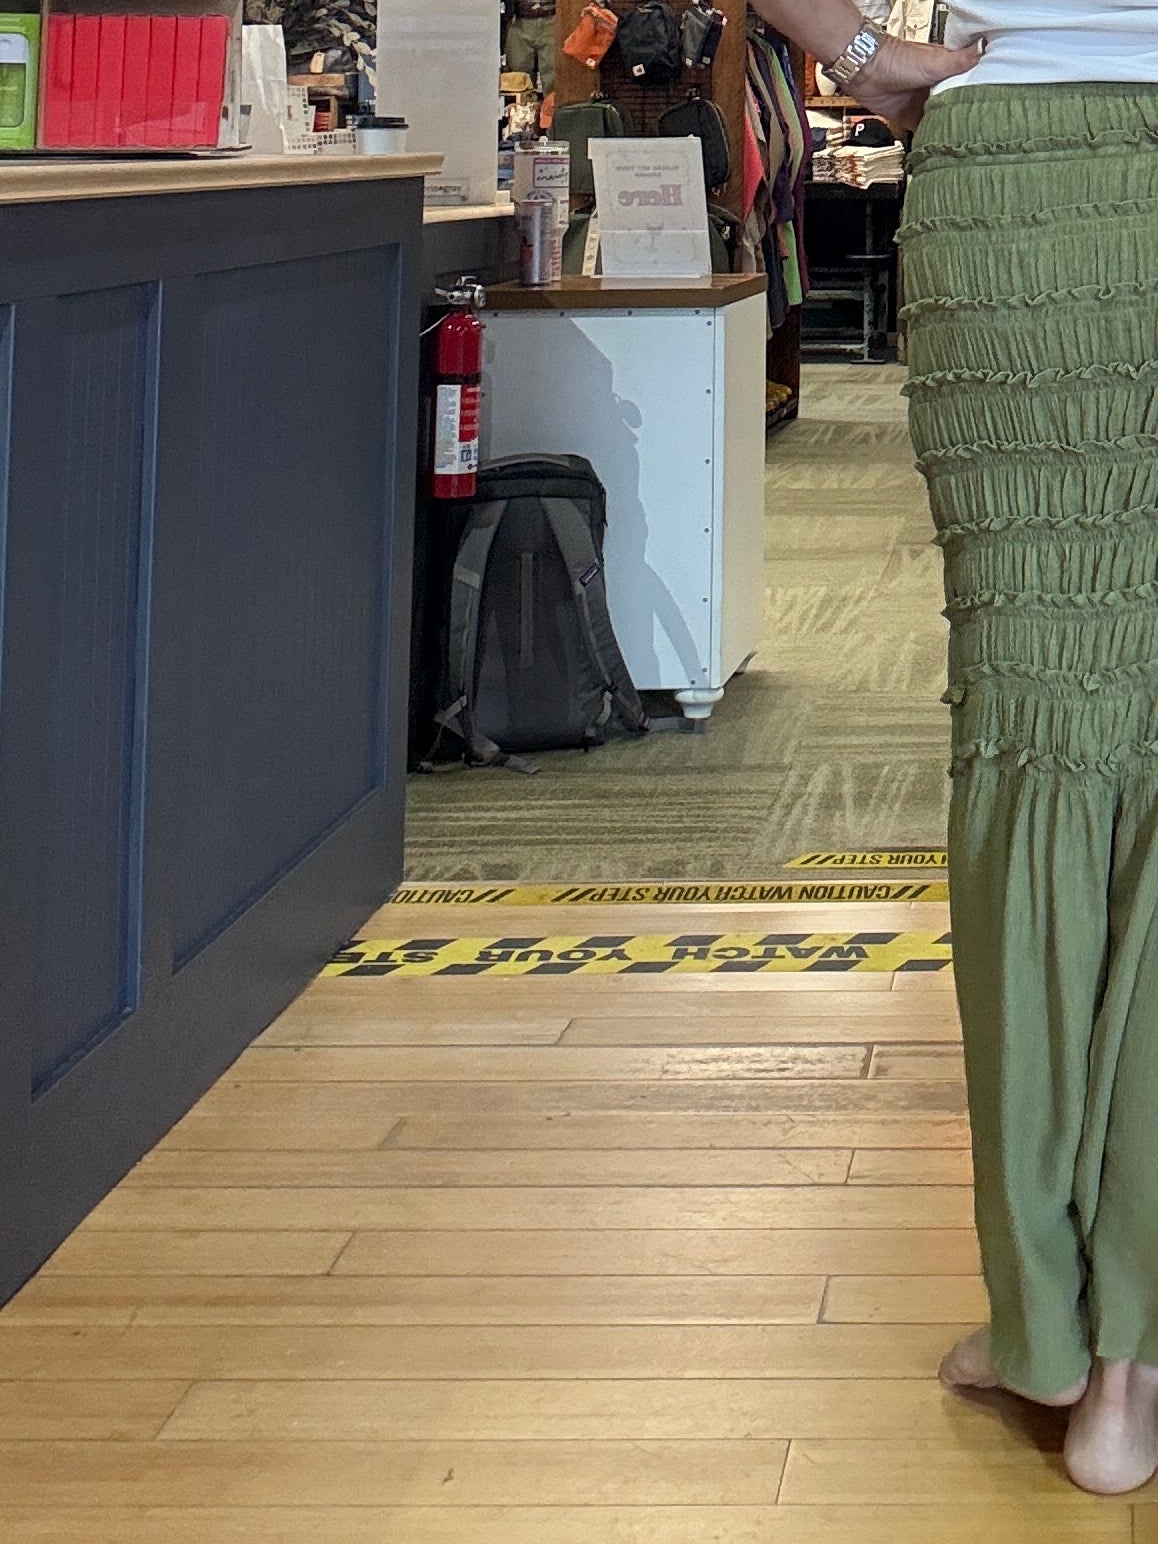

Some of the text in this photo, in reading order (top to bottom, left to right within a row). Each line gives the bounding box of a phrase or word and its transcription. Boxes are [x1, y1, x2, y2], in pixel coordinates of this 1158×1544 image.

[854, 123, 865, 137] P
[834, 854, 944, 865] YOUR STEP
[392, 888, 476, 904] CAUTIO
[588, 884, 891, 903] CAUTION WATCH YOUR STEP
[330, 945, 870, 964] WATCH YOUR STE
